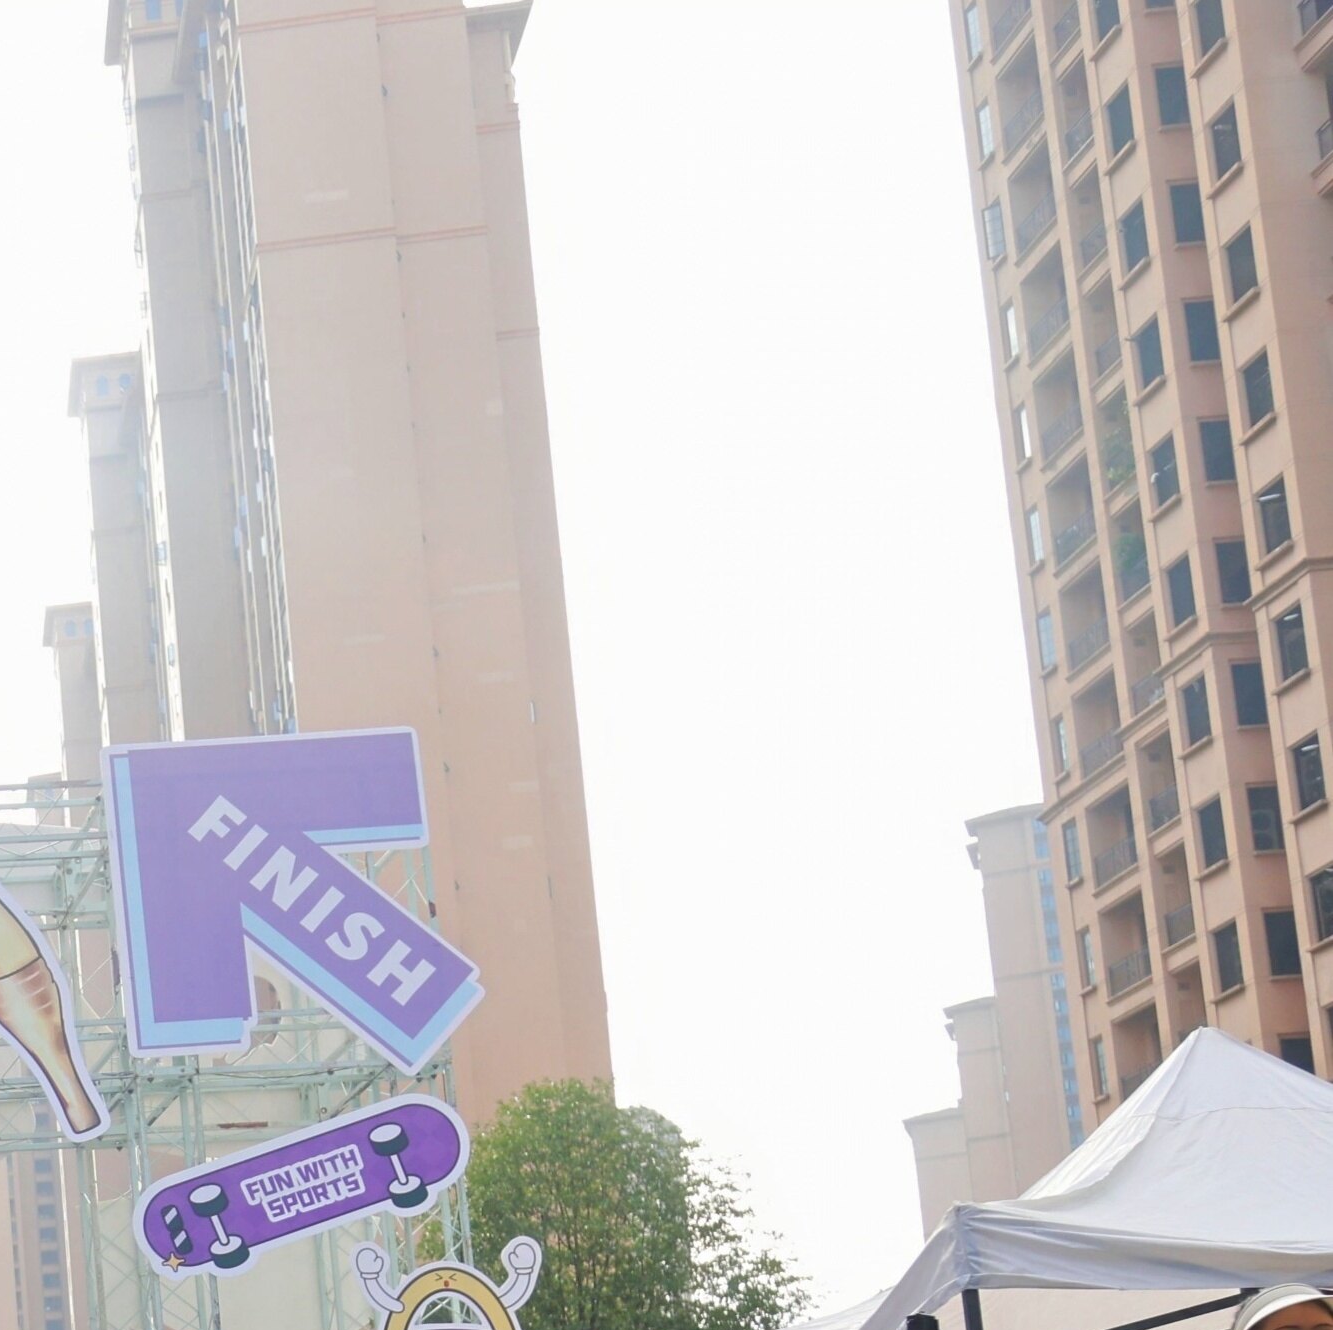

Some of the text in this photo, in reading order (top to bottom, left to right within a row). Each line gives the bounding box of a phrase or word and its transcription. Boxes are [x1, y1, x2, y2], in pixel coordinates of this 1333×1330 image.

[187, 794, 436, 1007] FINISH
[245, 1148, 359, 1202] FUN WITH
[266, 1172, 361, 1218] SPORTS
